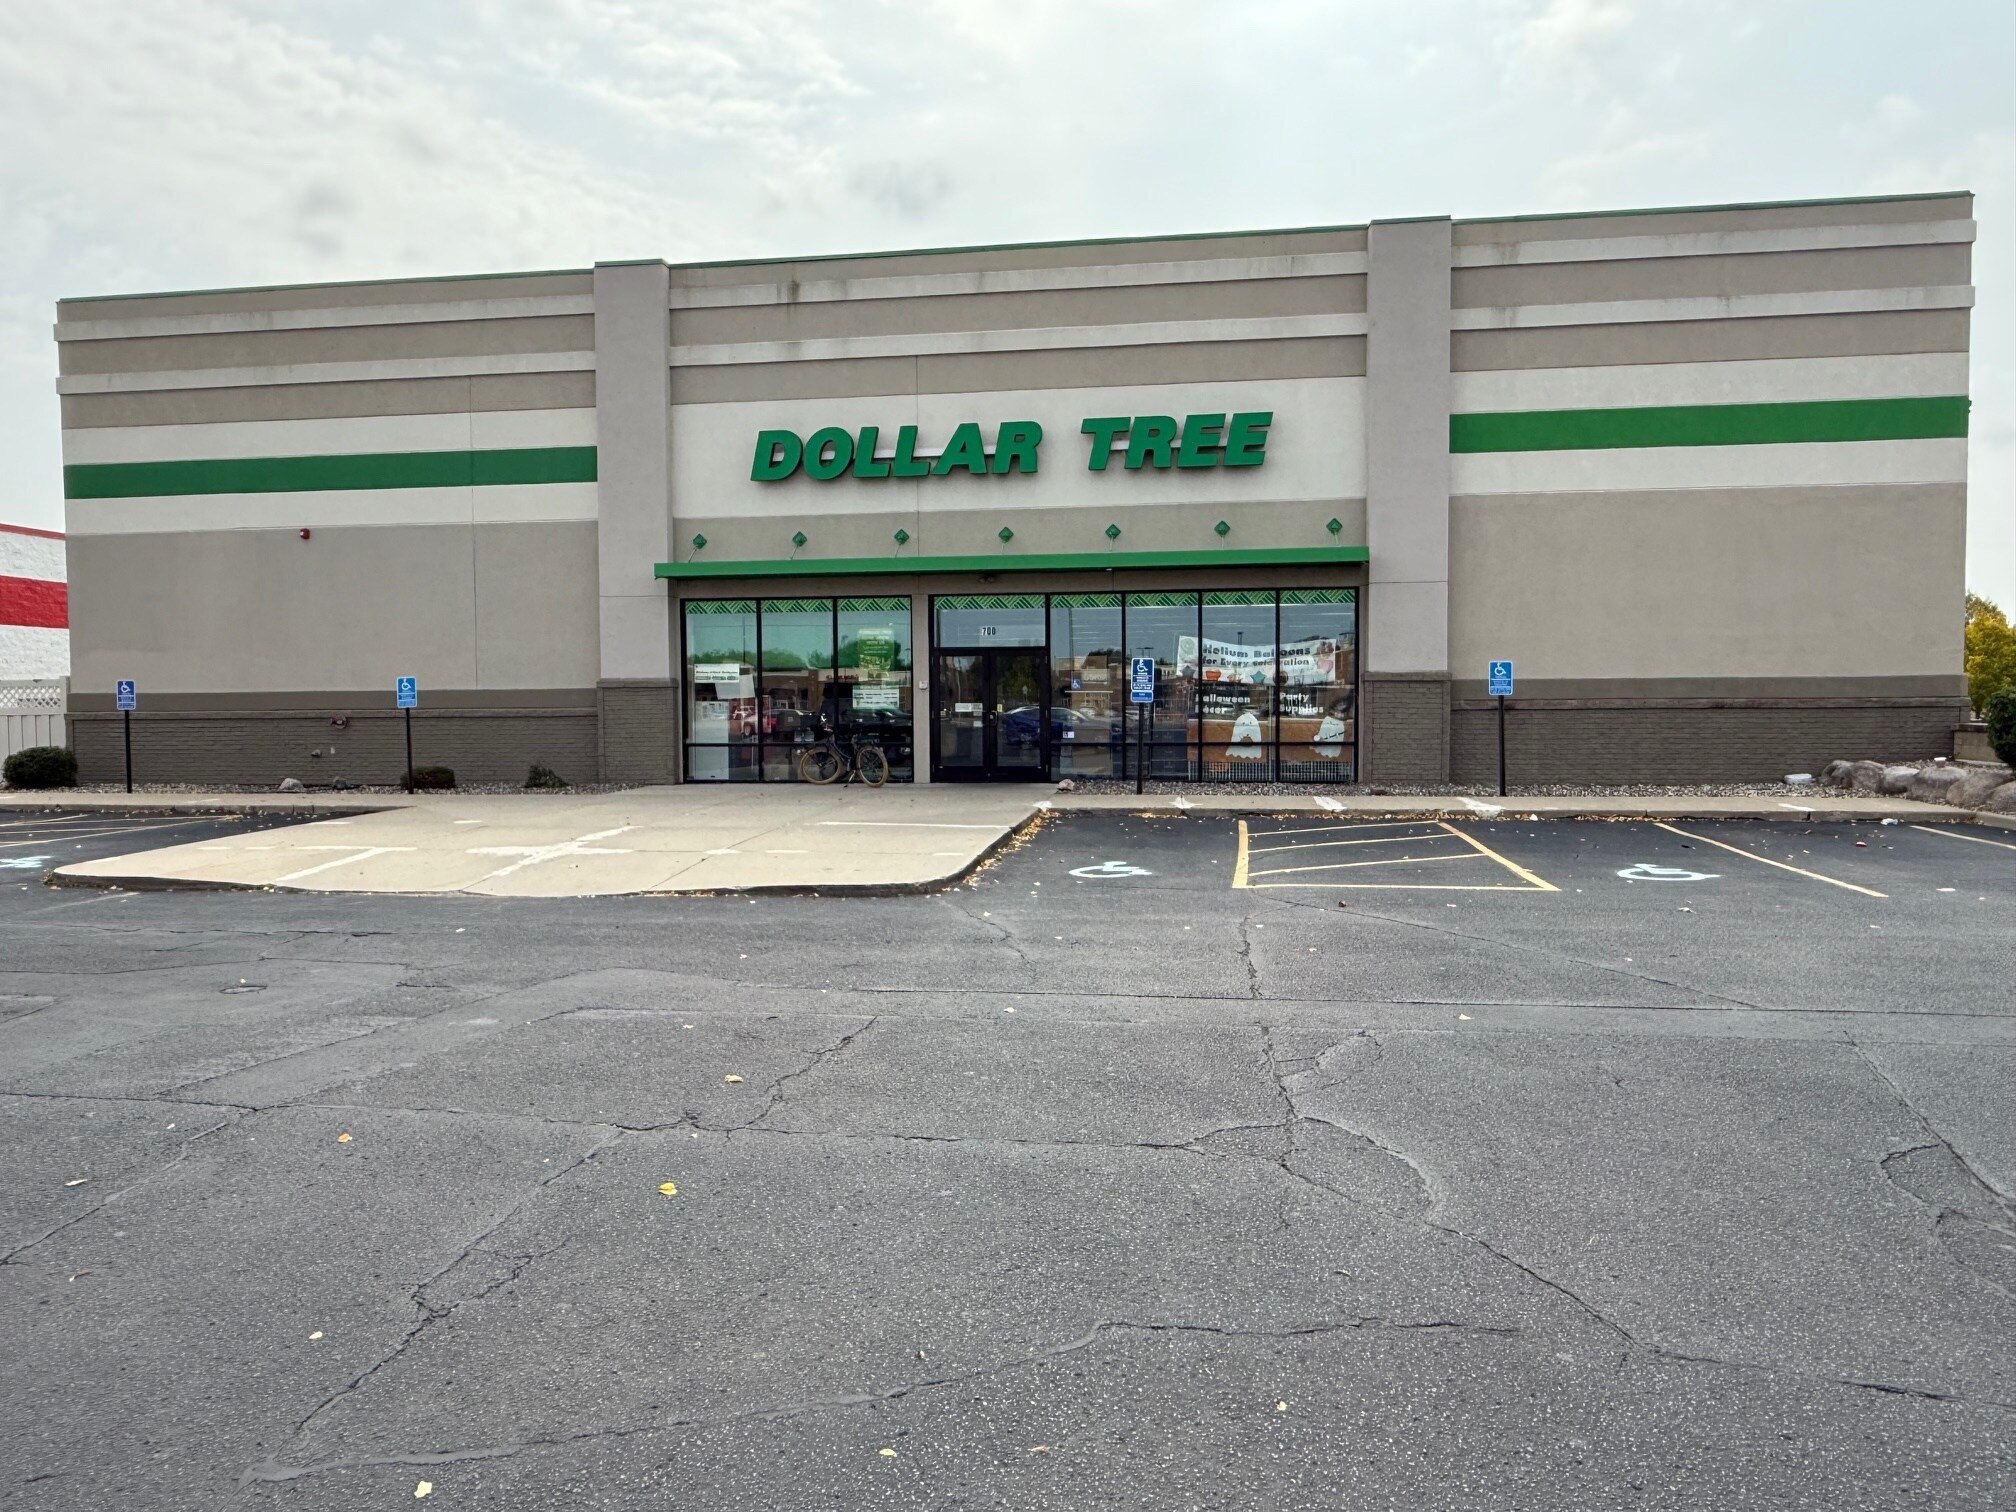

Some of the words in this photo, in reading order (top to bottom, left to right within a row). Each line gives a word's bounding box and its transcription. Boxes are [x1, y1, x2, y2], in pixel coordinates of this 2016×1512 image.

[750, 421, 1042, 481] DOLLAR
[1081, 411, 1273, 471] TREE
[1202, 643, 1249, 658] Helium
[1253, 647, 1311, 658] Baloons
[1202, 655, 1217, 665] for
[1220, 657, 1249, 668] Every
[1252, 657, 1310, 667] celeation
[1280, 692, 1309, 703] Party
[1280, 703, 1324, 715] Supplies
